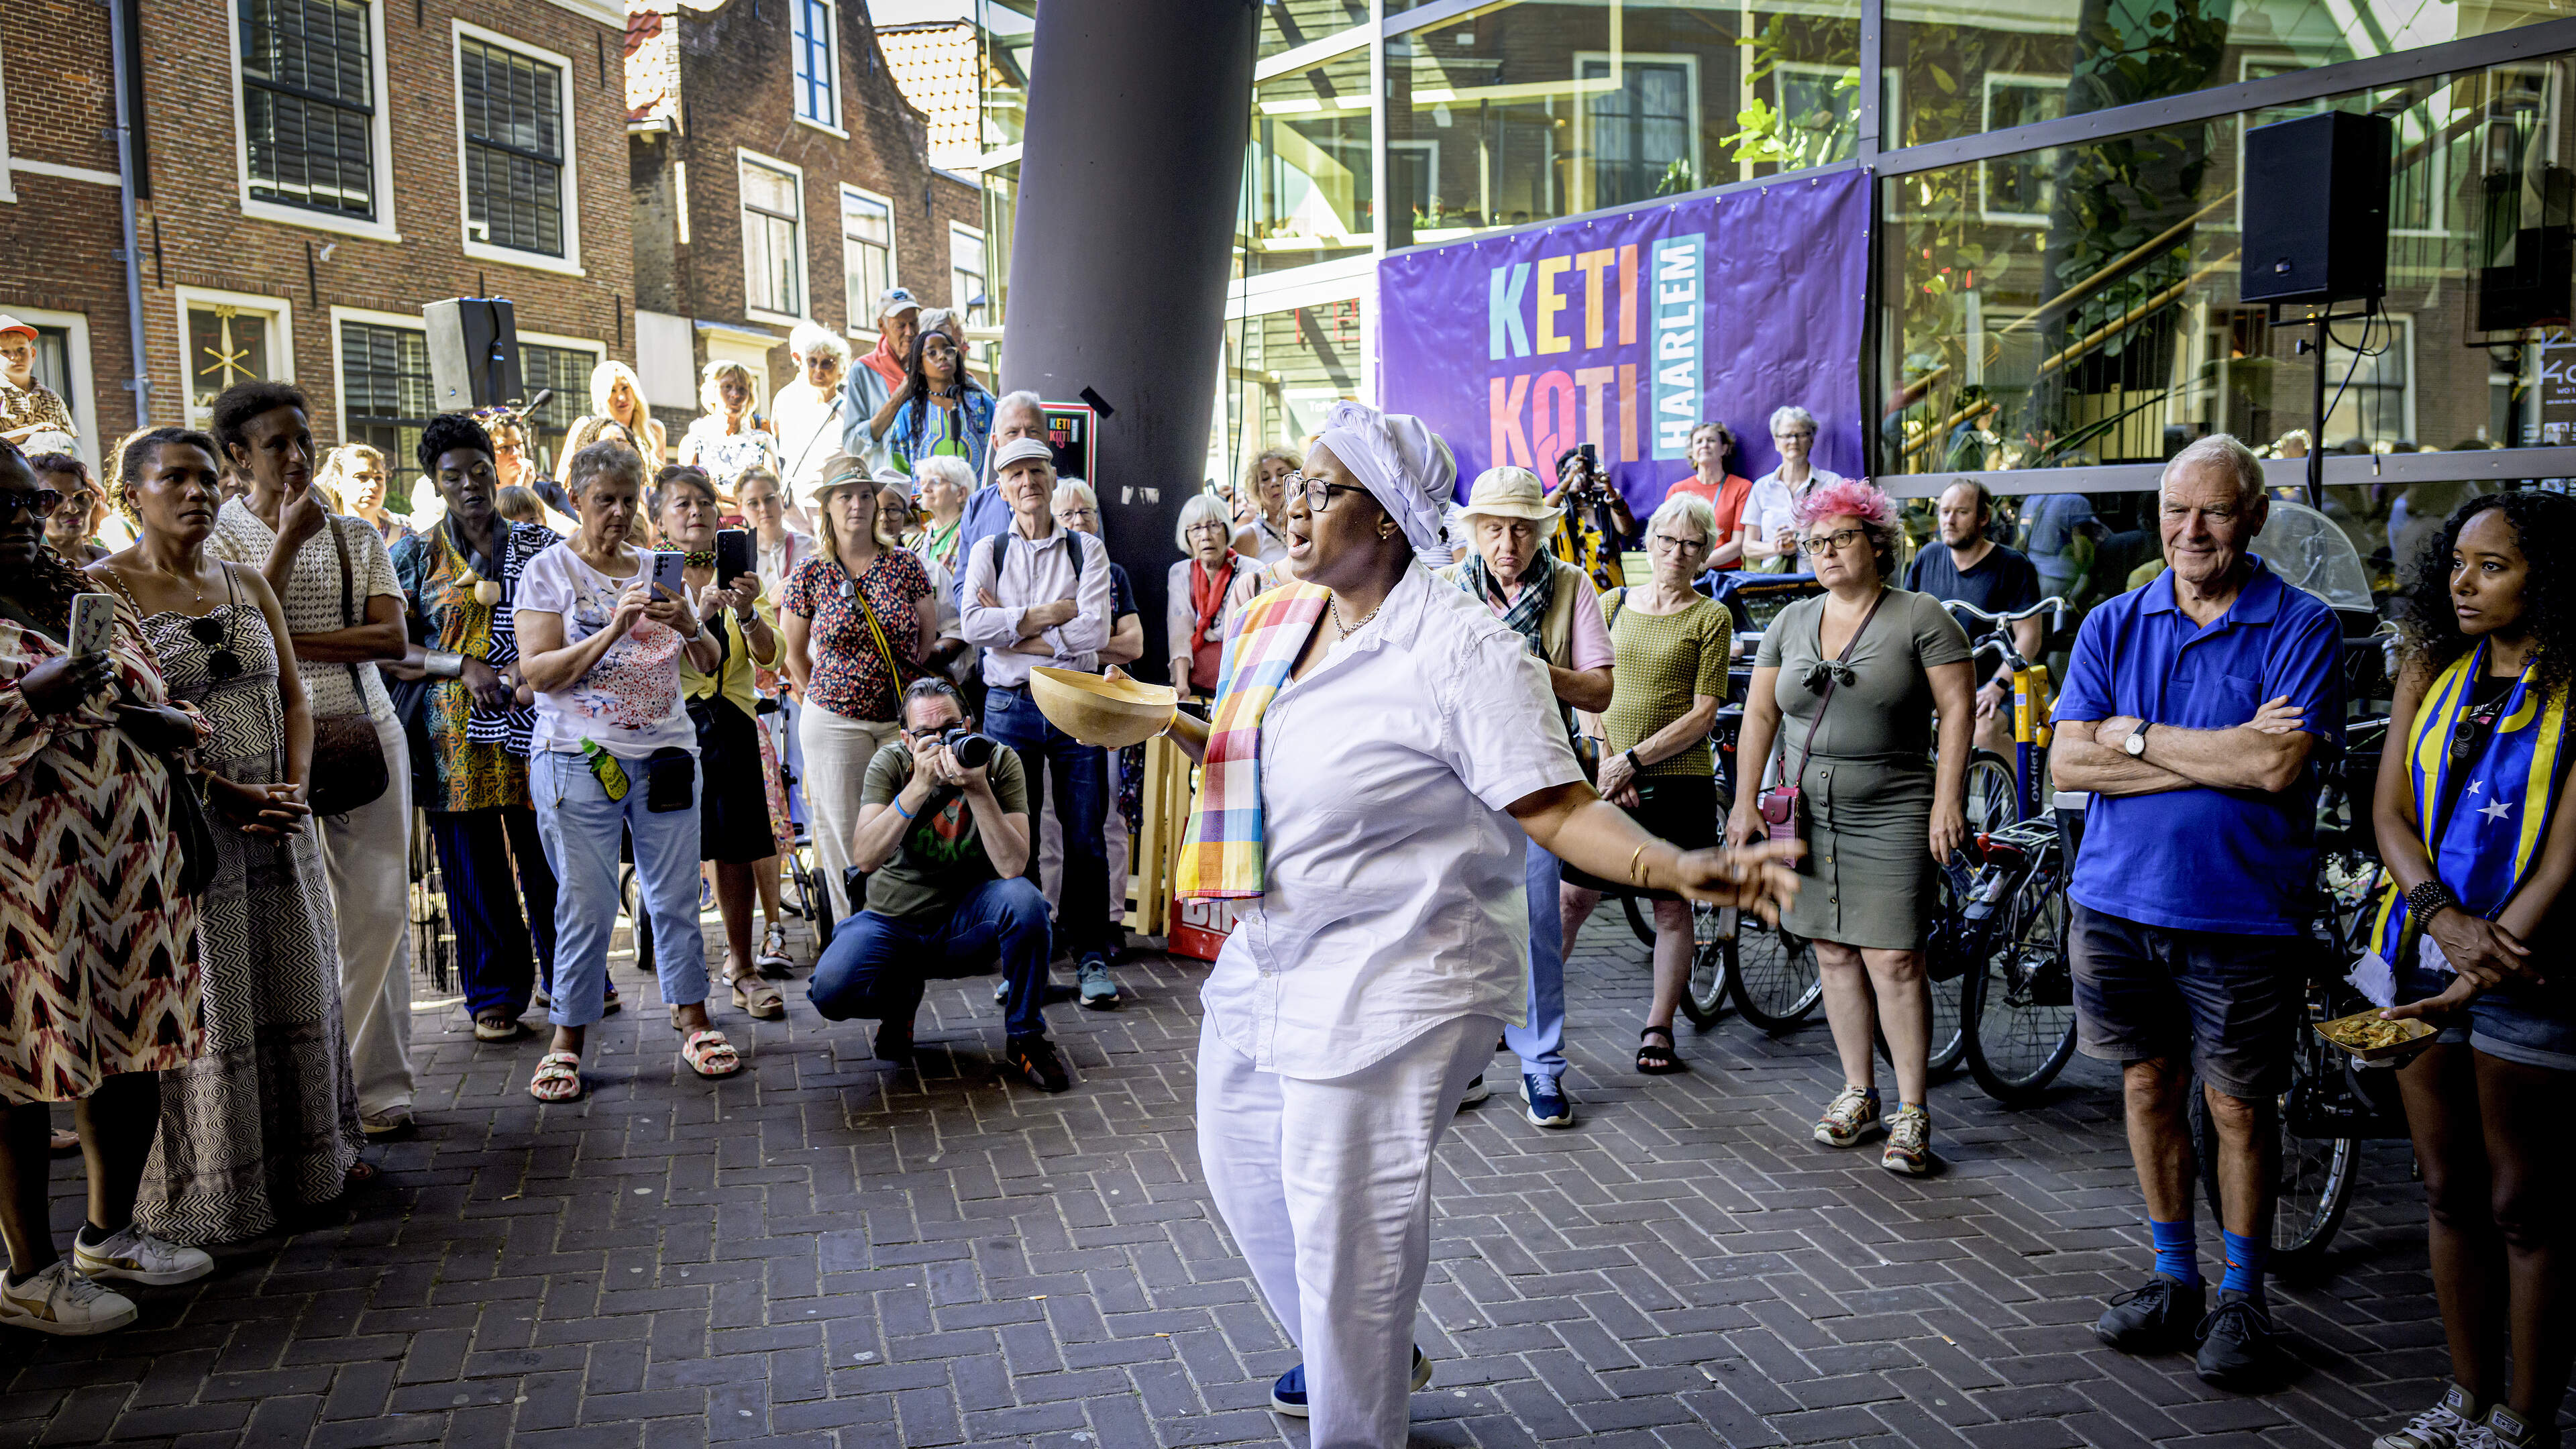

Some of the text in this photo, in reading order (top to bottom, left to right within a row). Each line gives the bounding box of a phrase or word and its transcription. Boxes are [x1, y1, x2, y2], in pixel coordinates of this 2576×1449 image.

[1489, 244, 1638, 361] KETI
[1659, 244, 1696, 449] HAARLEM
[1049, 418, 1071, 430] KETI
[1049, 430, 1071, 449] KOTI
[1490, 364, 1639, 490] KOTI
